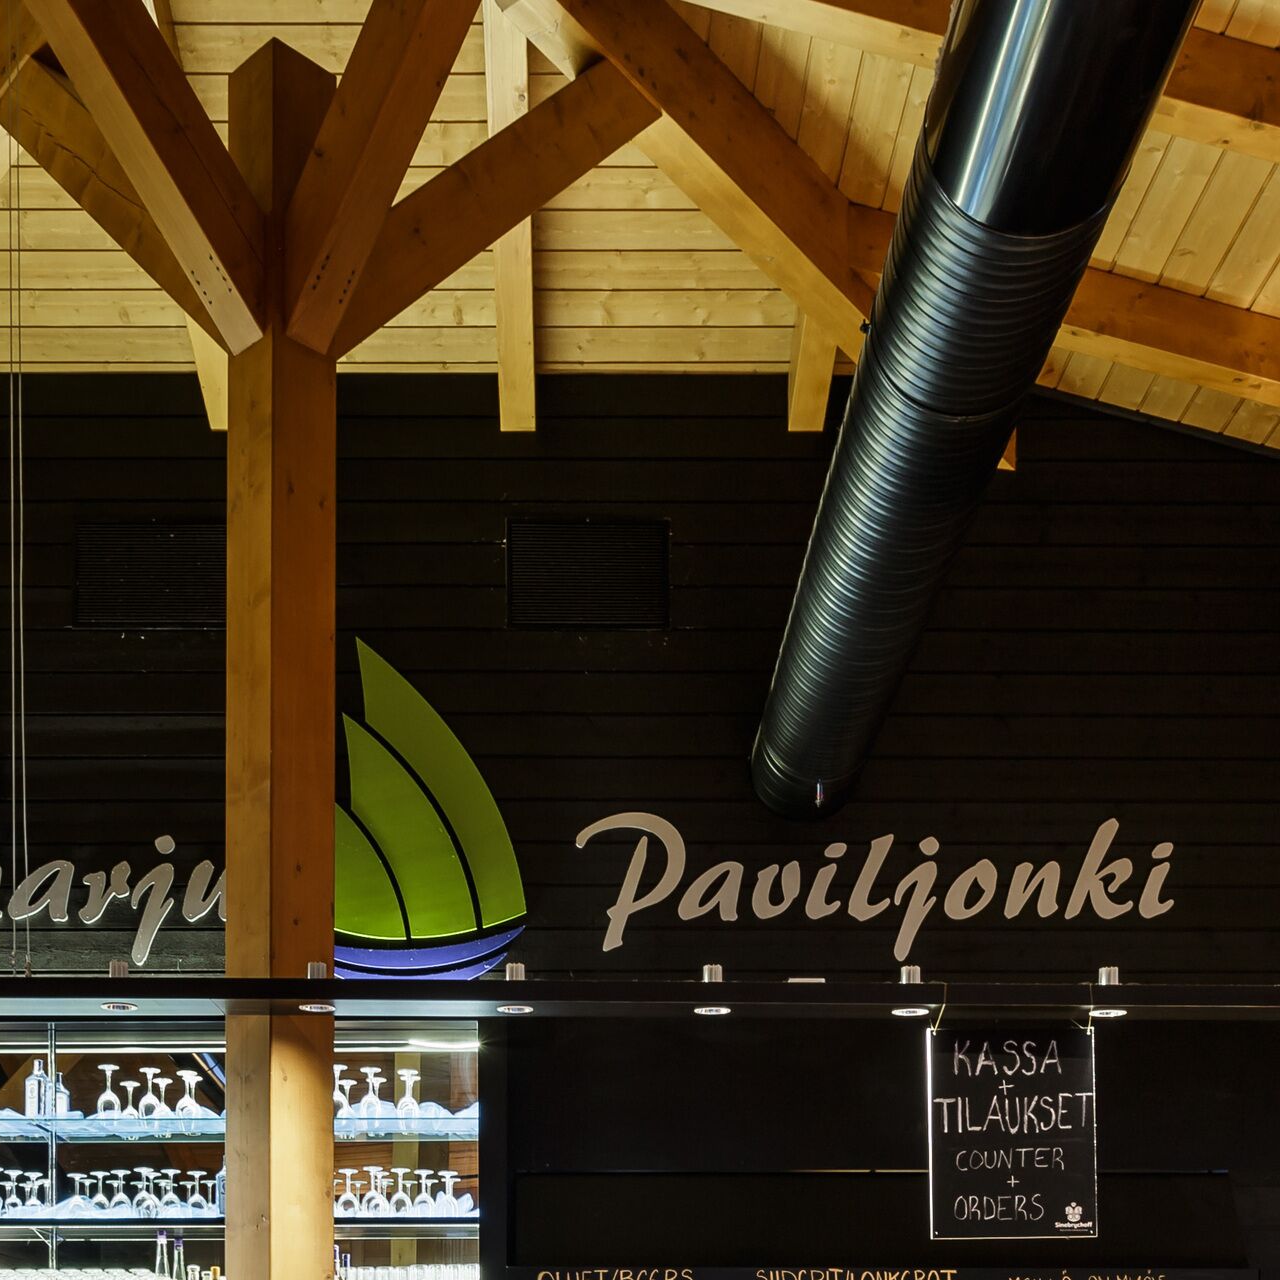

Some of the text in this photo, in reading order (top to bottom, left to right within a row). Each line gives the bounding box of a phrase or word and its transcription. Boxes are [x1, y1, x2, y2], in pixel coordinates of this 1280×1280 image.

[575, 811, 1174, 961] Paviljonki
[953, 1039, 1062, 1077] KASSA
[933, 1092, 1094, 1135] TILAUKSET
[955, 1147, 1065, 1171] COUNTER
[953, 1193, 1045, 1221] ORDERS
